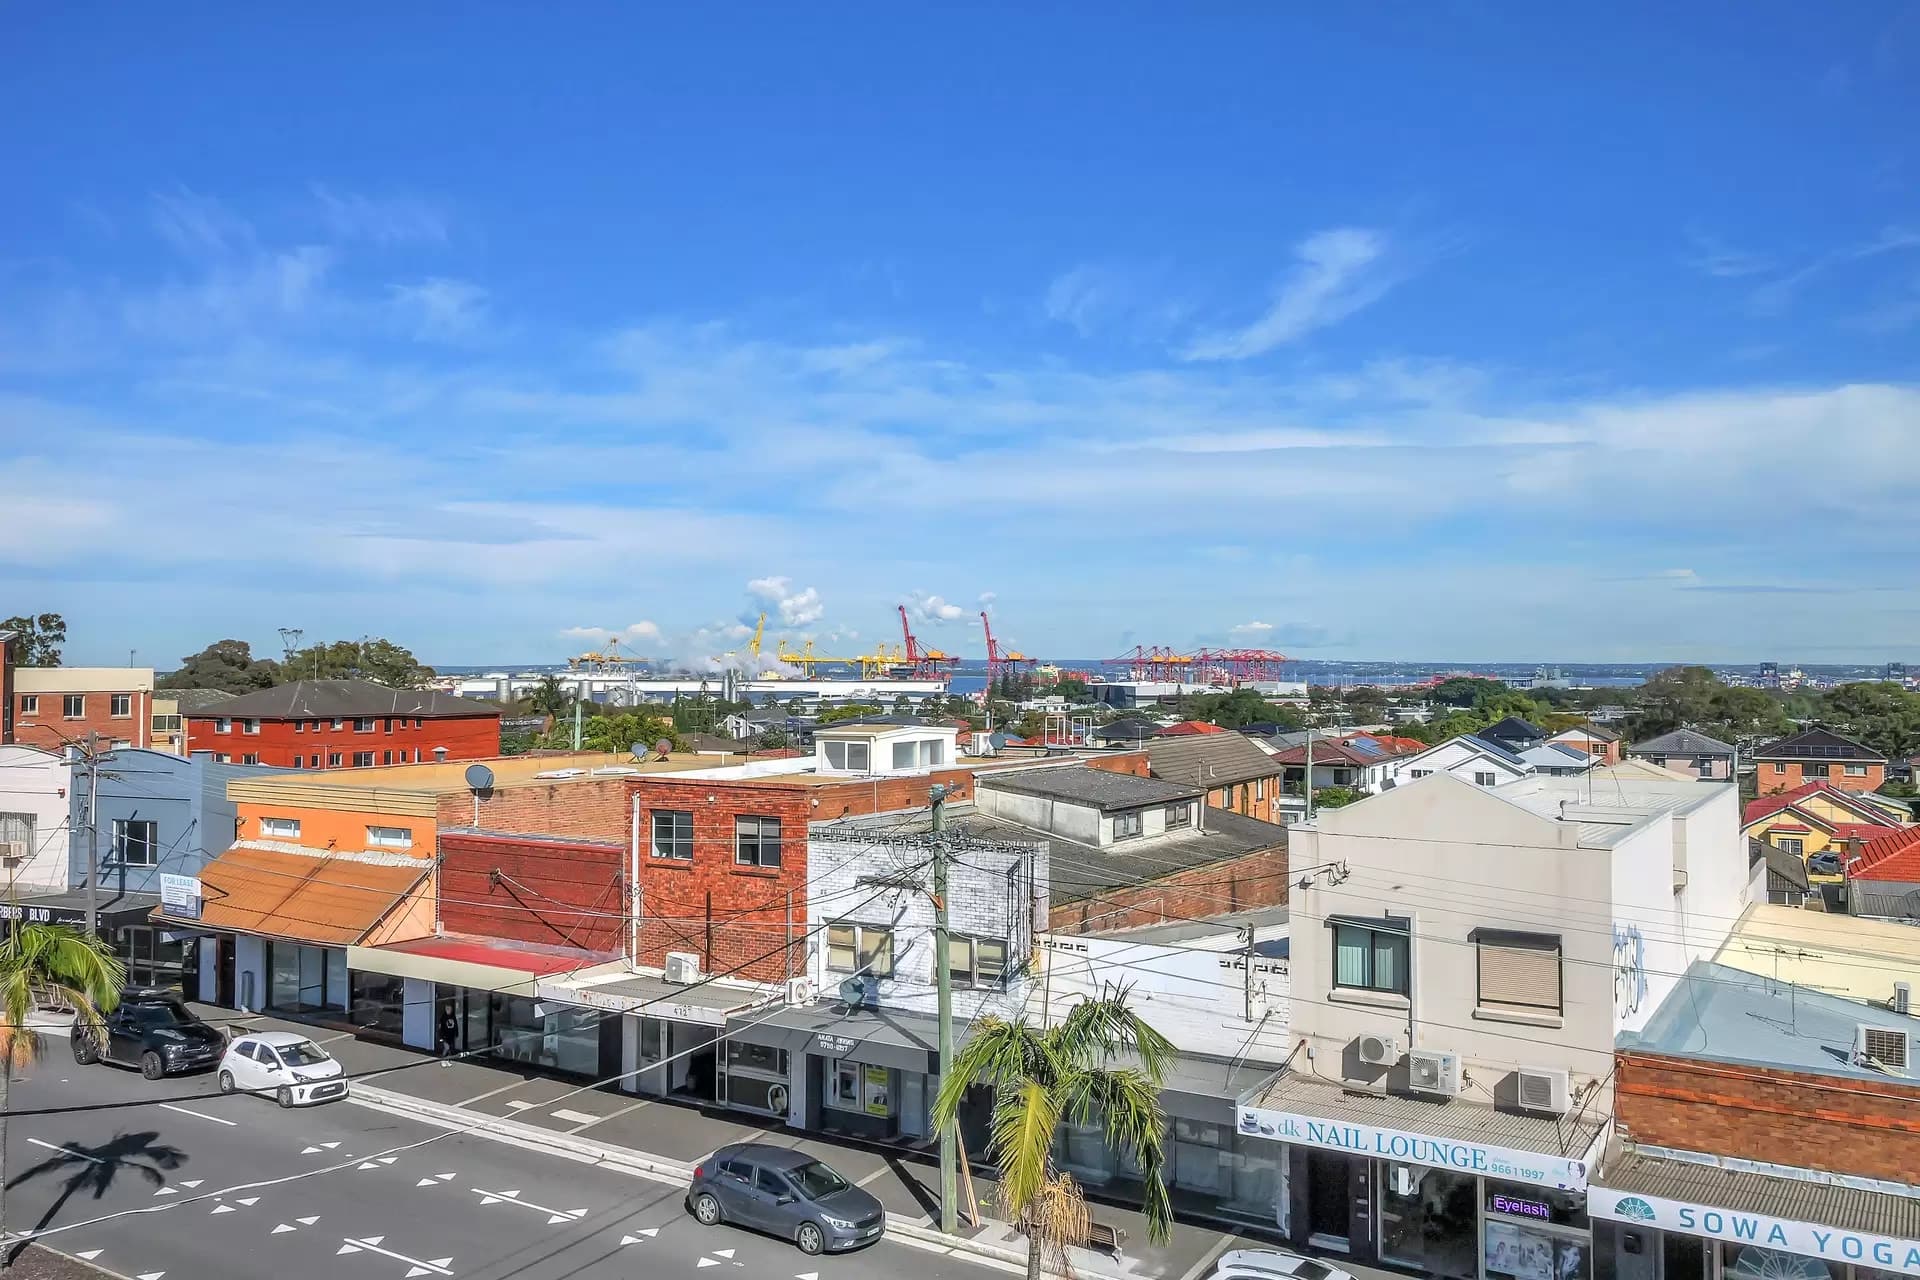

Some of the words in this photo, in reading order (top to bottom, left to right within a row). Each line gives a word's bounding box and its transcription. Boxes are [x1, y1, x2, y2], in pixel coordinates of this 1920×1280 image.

[29, 908, 50, 922] BLVD
[1278, 1119, 1300, 1137] dk
[1306, 1121, 1368, 1151] NAIL
[1375, 1132, 1488, 1172] LOUNGE
[1495, 1197, 1548, 1218] Eyelash
[1679, 1208, 1788, 1247] SOWA
[1812, 1230, 1920, 1269] YOGA
